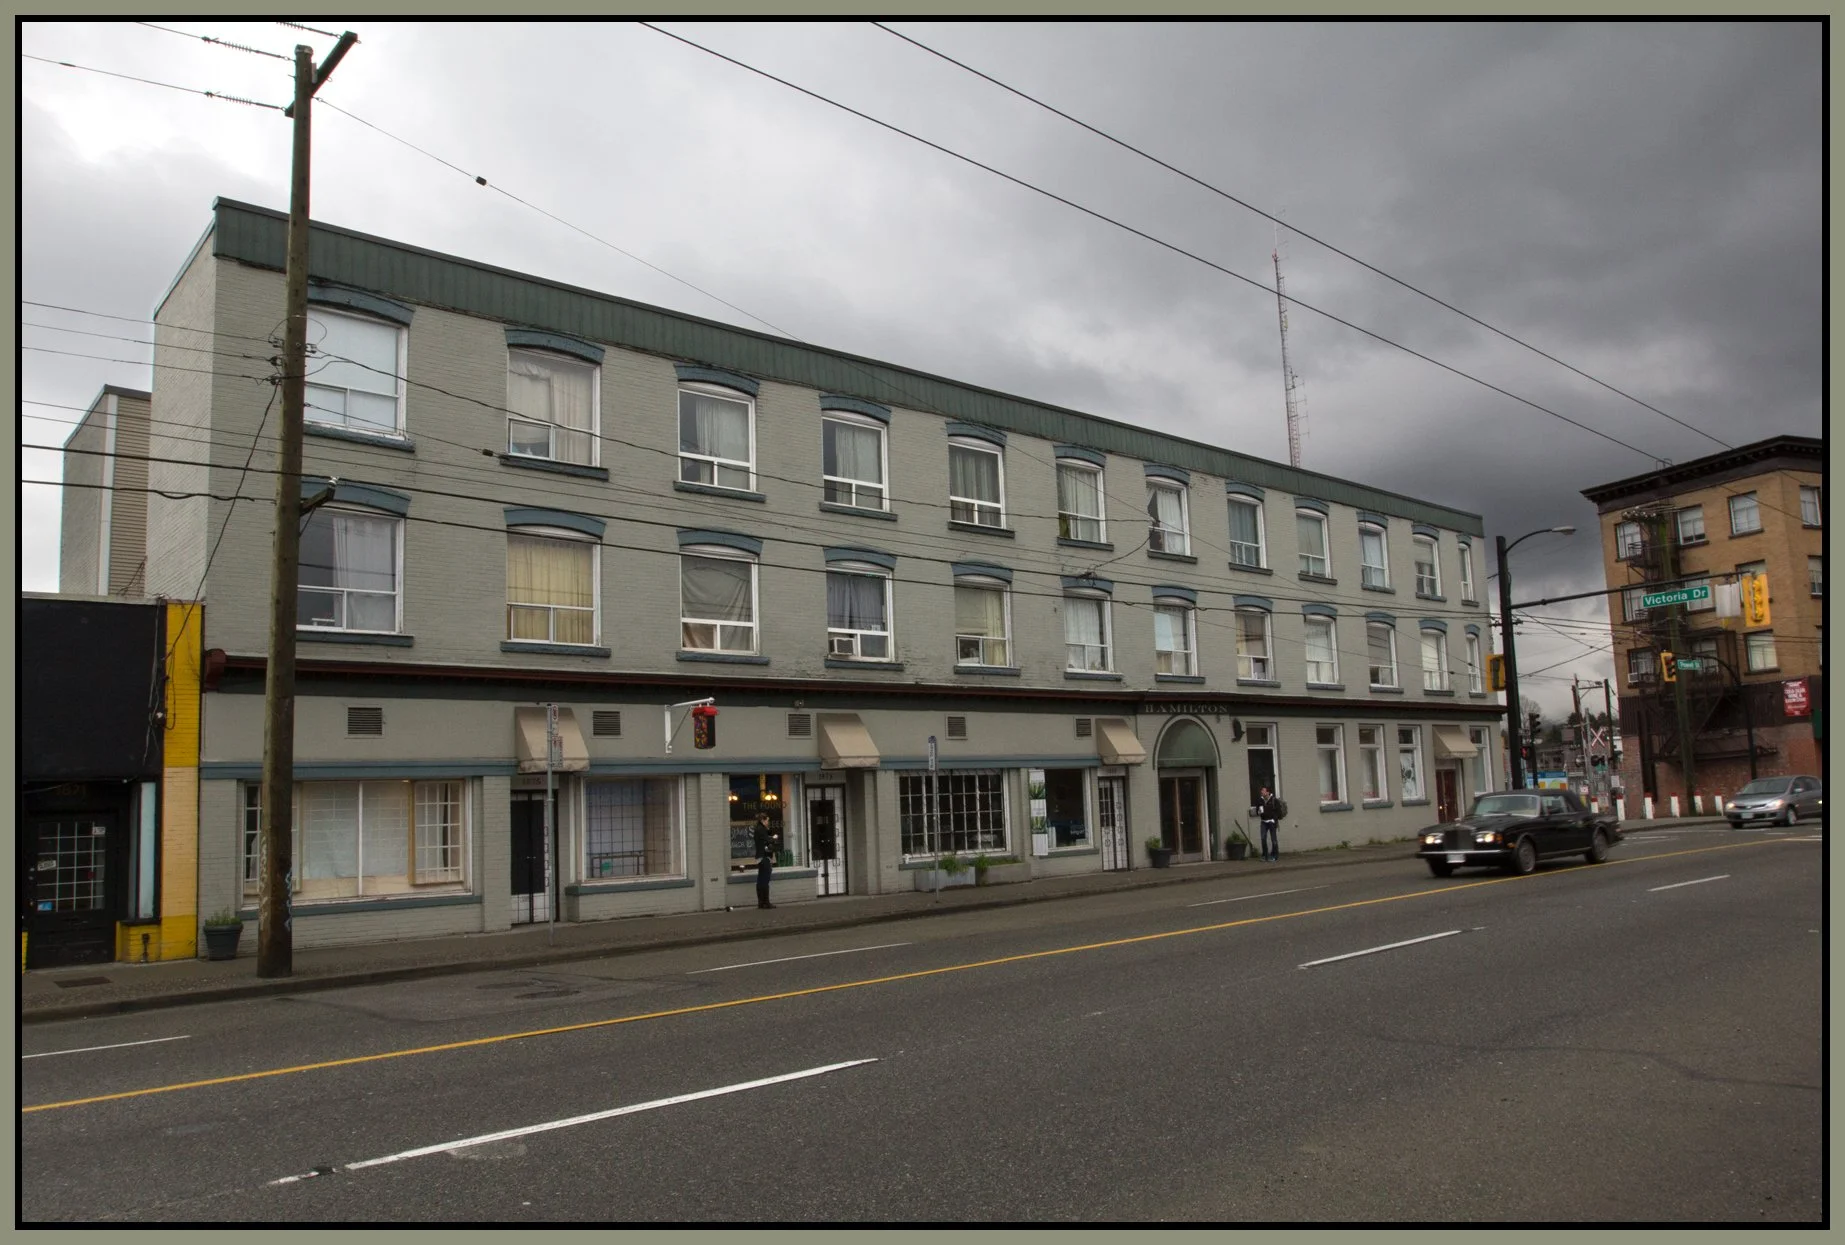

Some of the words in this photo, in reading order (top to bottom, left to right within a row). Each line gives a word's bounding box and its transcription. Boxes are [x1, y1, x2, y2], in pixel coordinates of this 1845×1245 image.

[1644, 591, 1688, 606] Victoria
[1692, 589, 1706, 598] Dr
[1144, 703, 1229, 713] HAMILTON
[742, 802, 757, 810] THE
[760, 801, 787, 809] FOUND
